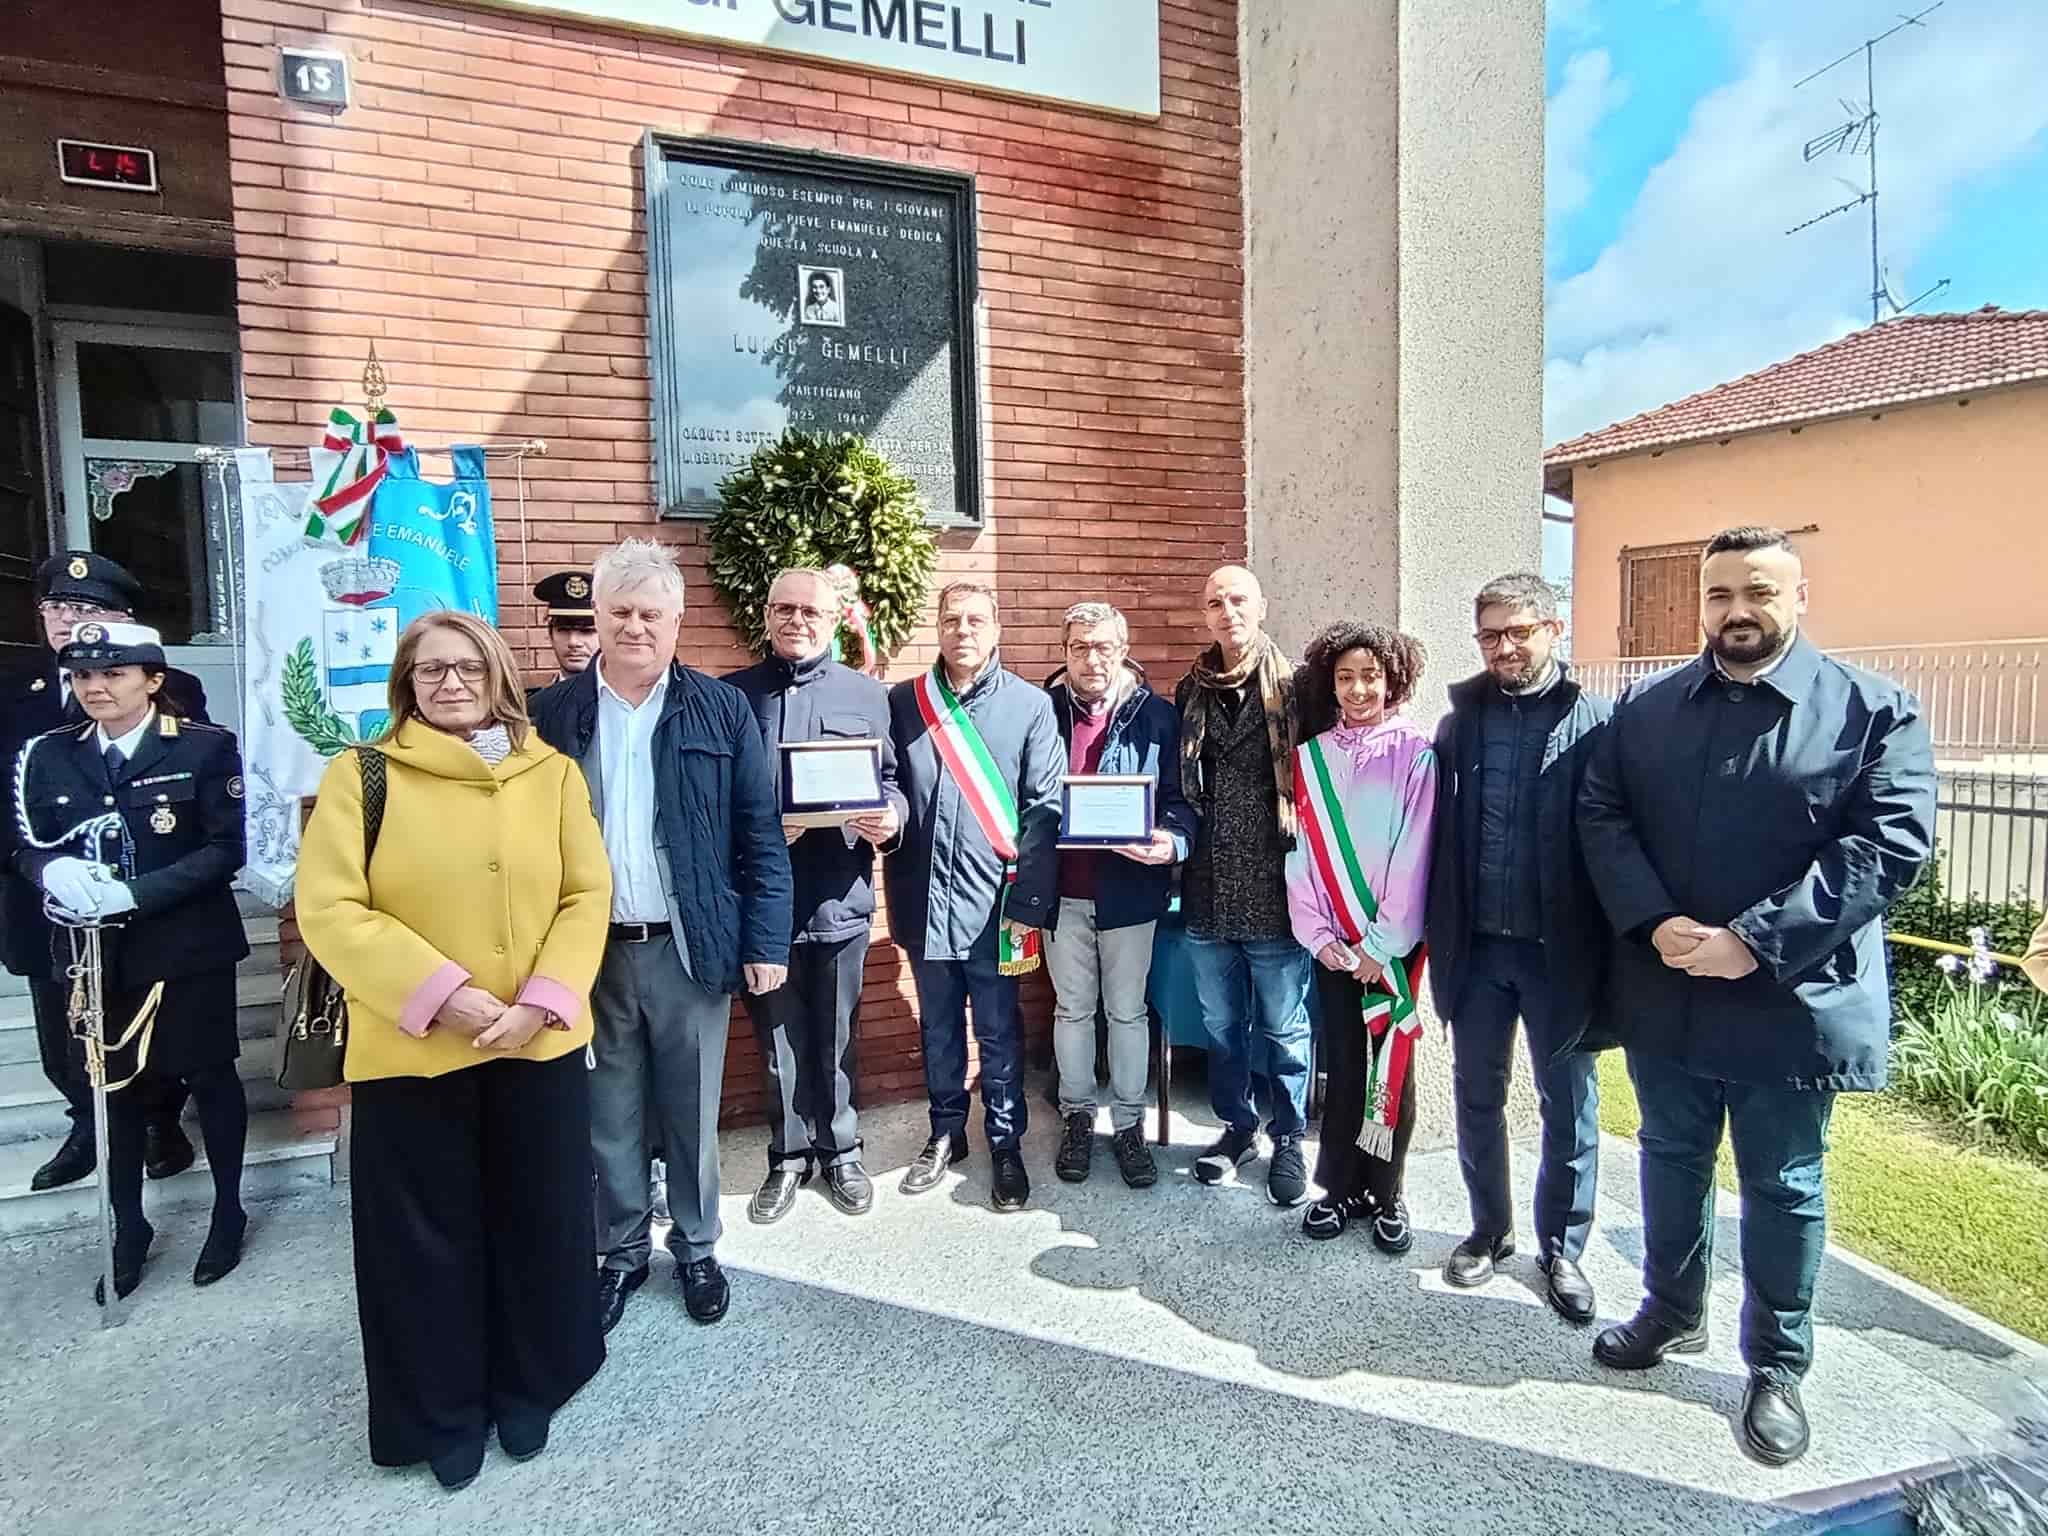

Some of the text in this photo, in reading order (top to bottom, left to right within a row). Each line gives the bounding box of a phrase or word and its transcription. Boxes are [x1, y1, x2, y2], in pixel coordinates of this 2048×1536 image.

[772, 0, 1026, 65] GEMELLI
[296, 64, 332, 92] 15
[721, 180, 786, 200] LUMINOSO
[792, 188, 844, 206] ESEMPIO
[852, 196, 874, 211] PER
[895, 202, 945, 220] GIOVANI
[764, 209, 777, 223] DI
[786, 213, 823, 229] PIEVE
[830, 217, 890, 238] EMANUELE
[900, 227, 943, 244] DEDICA
[759, 234, 879, 260] QUESTA SCUOLA A
[821, 340, 909, 366] GEMELLI
[788, 383, 862, 401] PARTIGIANO
[387, 523, 473, 572] EMANUELE
